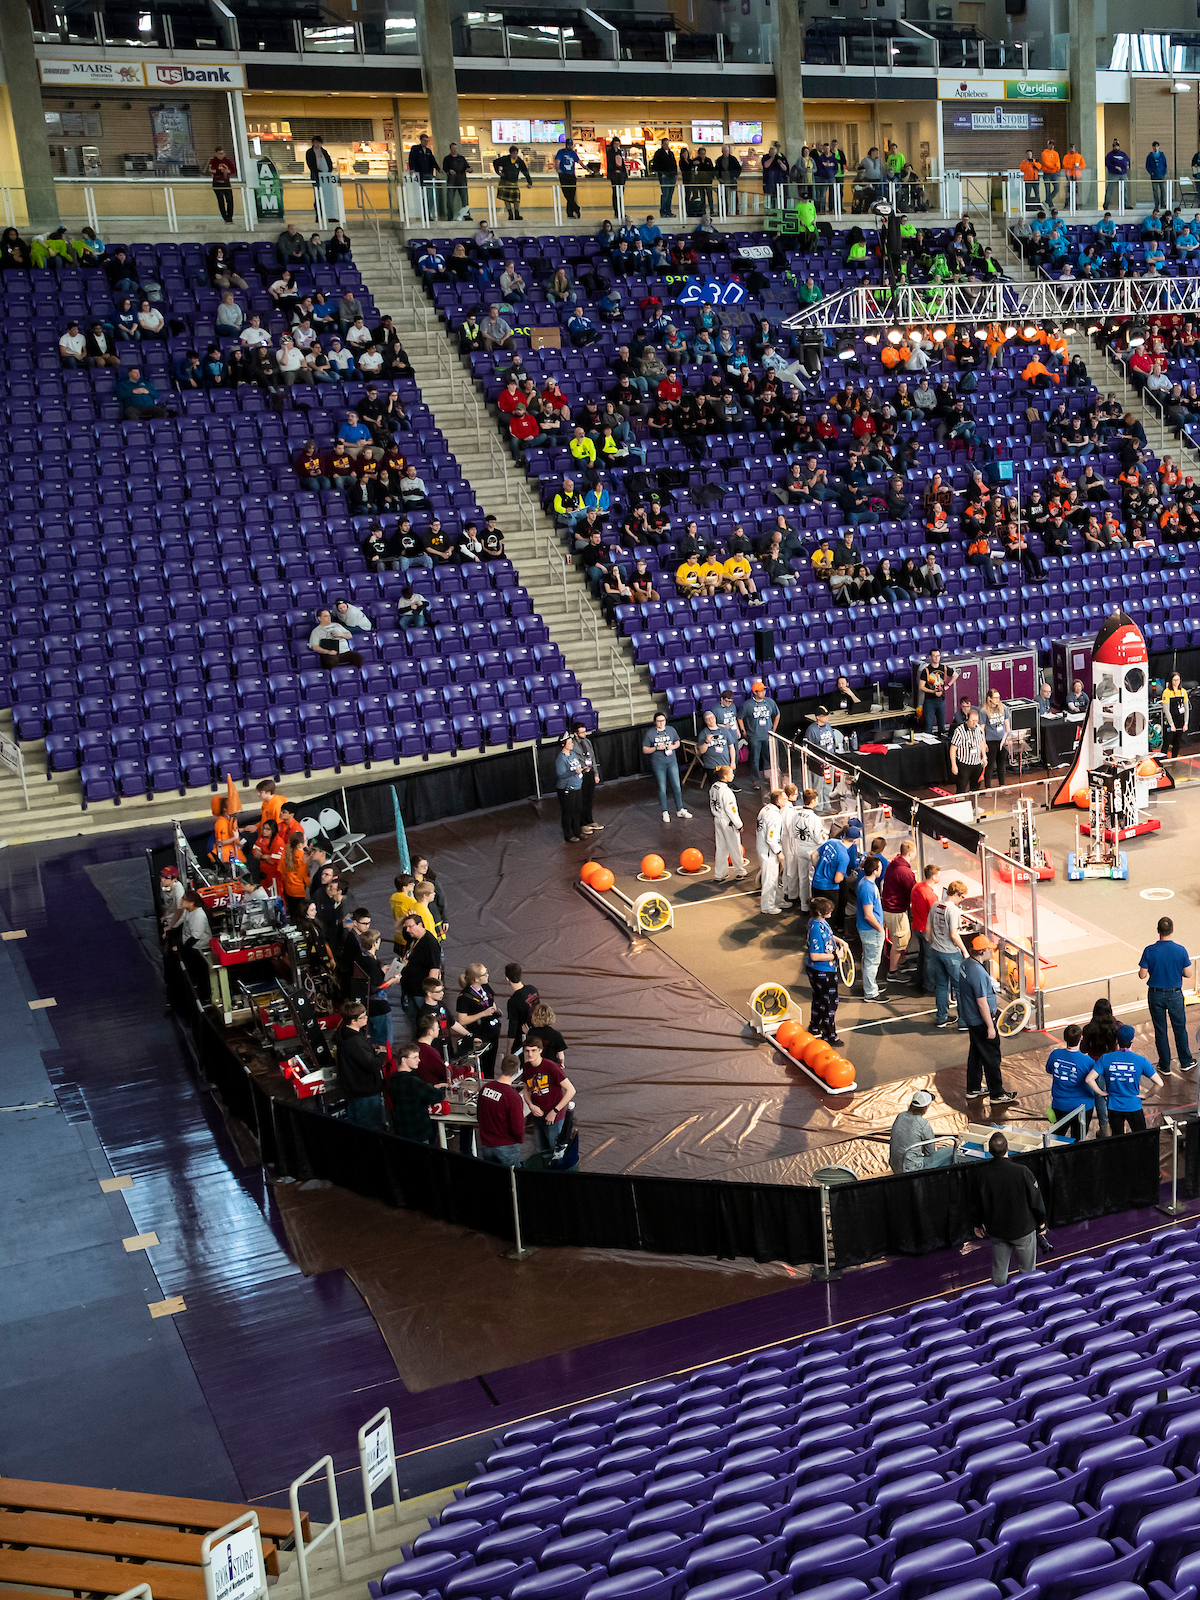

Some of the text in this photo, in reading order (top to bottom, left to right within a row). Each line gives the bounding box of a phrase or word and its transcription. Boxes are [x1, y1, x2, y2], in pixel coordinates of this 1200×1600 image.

[72, 64, 112, 73] MARS
[1020, 82, 1058, 93] Veridian
[973, 115, 1028, 124] BOOK STORE
[320, 175, 337, 184] 113
[403, 175, 419, 184] 114
[260, 164, 278, 210] ATM
[742, 246, 771, 257] 930
[665, 275, 688, 285] 930
[718, 312, 752, 326] 930
[962, 672, 971, 680] 07
[1017, 872, 1040, 880] 660
[215, 1549, 254, 1592] BOOK STORE
[232, 1578, 245, 1590] Northern
